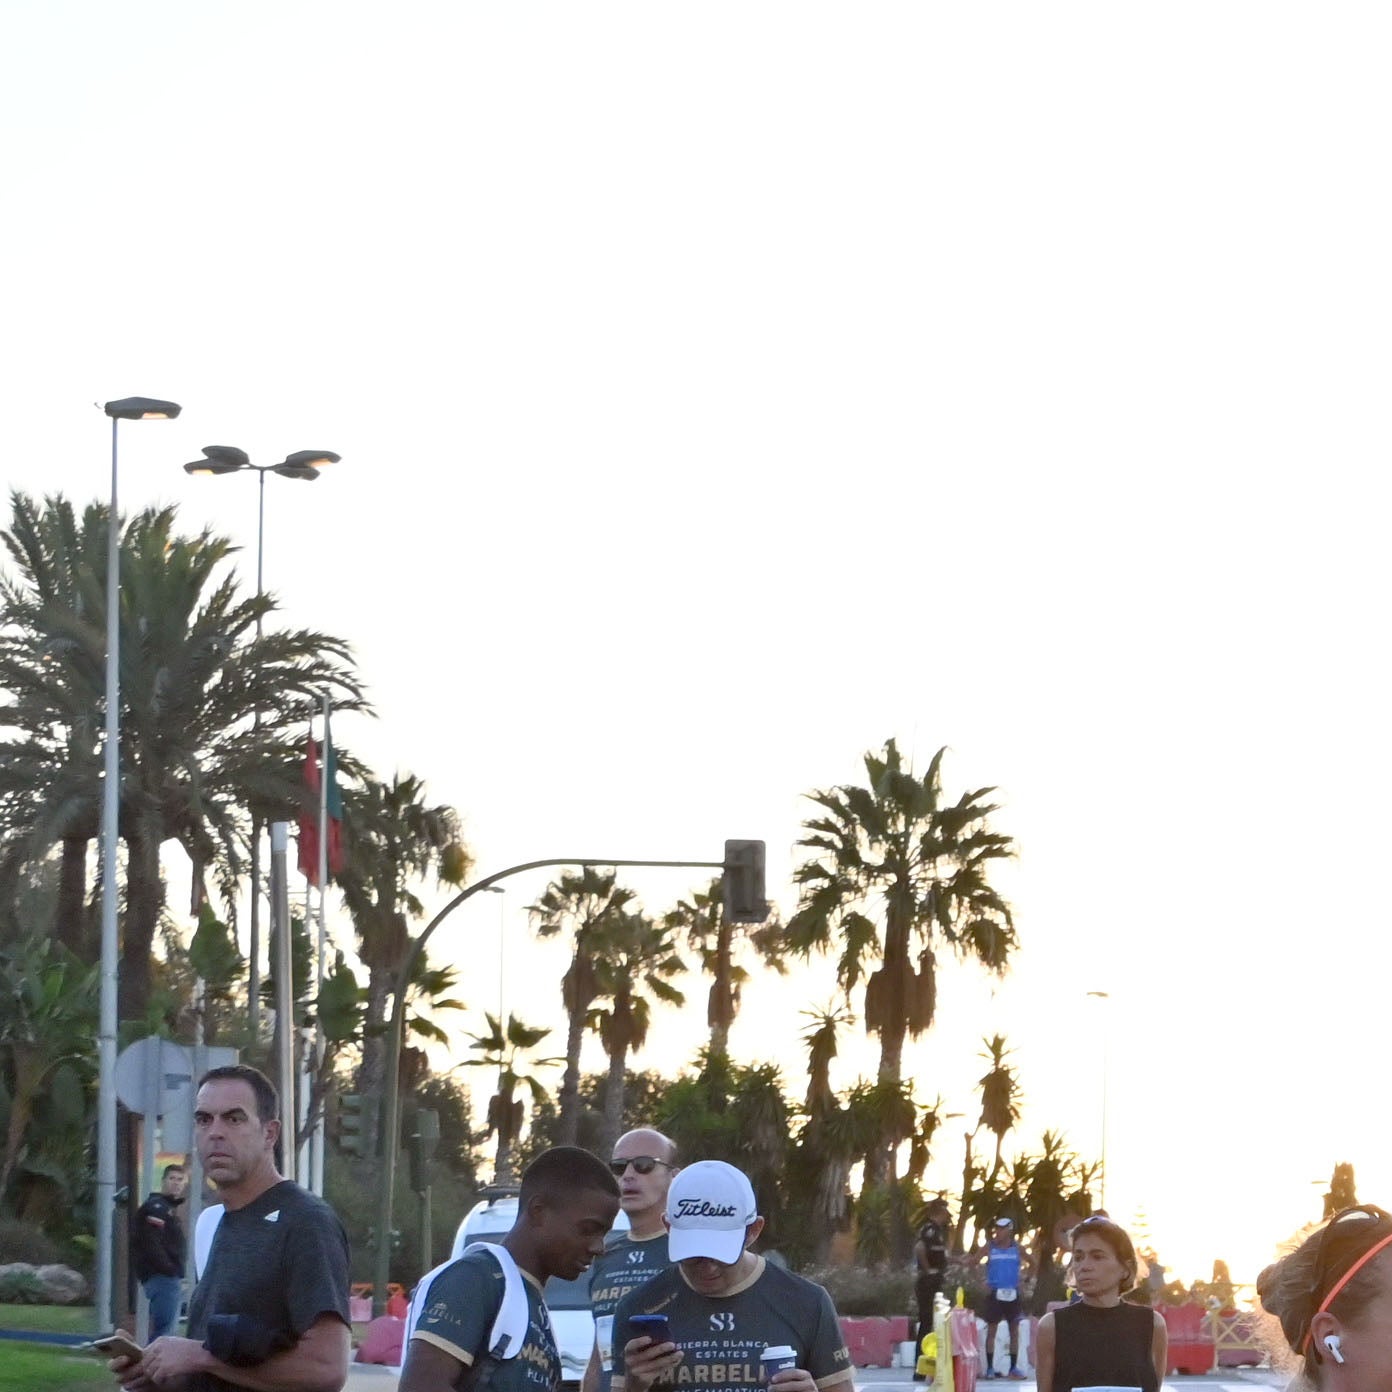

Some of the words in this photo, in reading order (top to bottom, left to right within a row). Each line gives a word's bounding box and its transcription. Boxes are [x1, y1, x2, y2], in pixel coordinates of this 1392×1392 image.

[673, 1198, 738, 1219] Titleist
[723, 1340, 769, 1349] BLANCA
[695, 1351, 749, 1360] ESTATES
